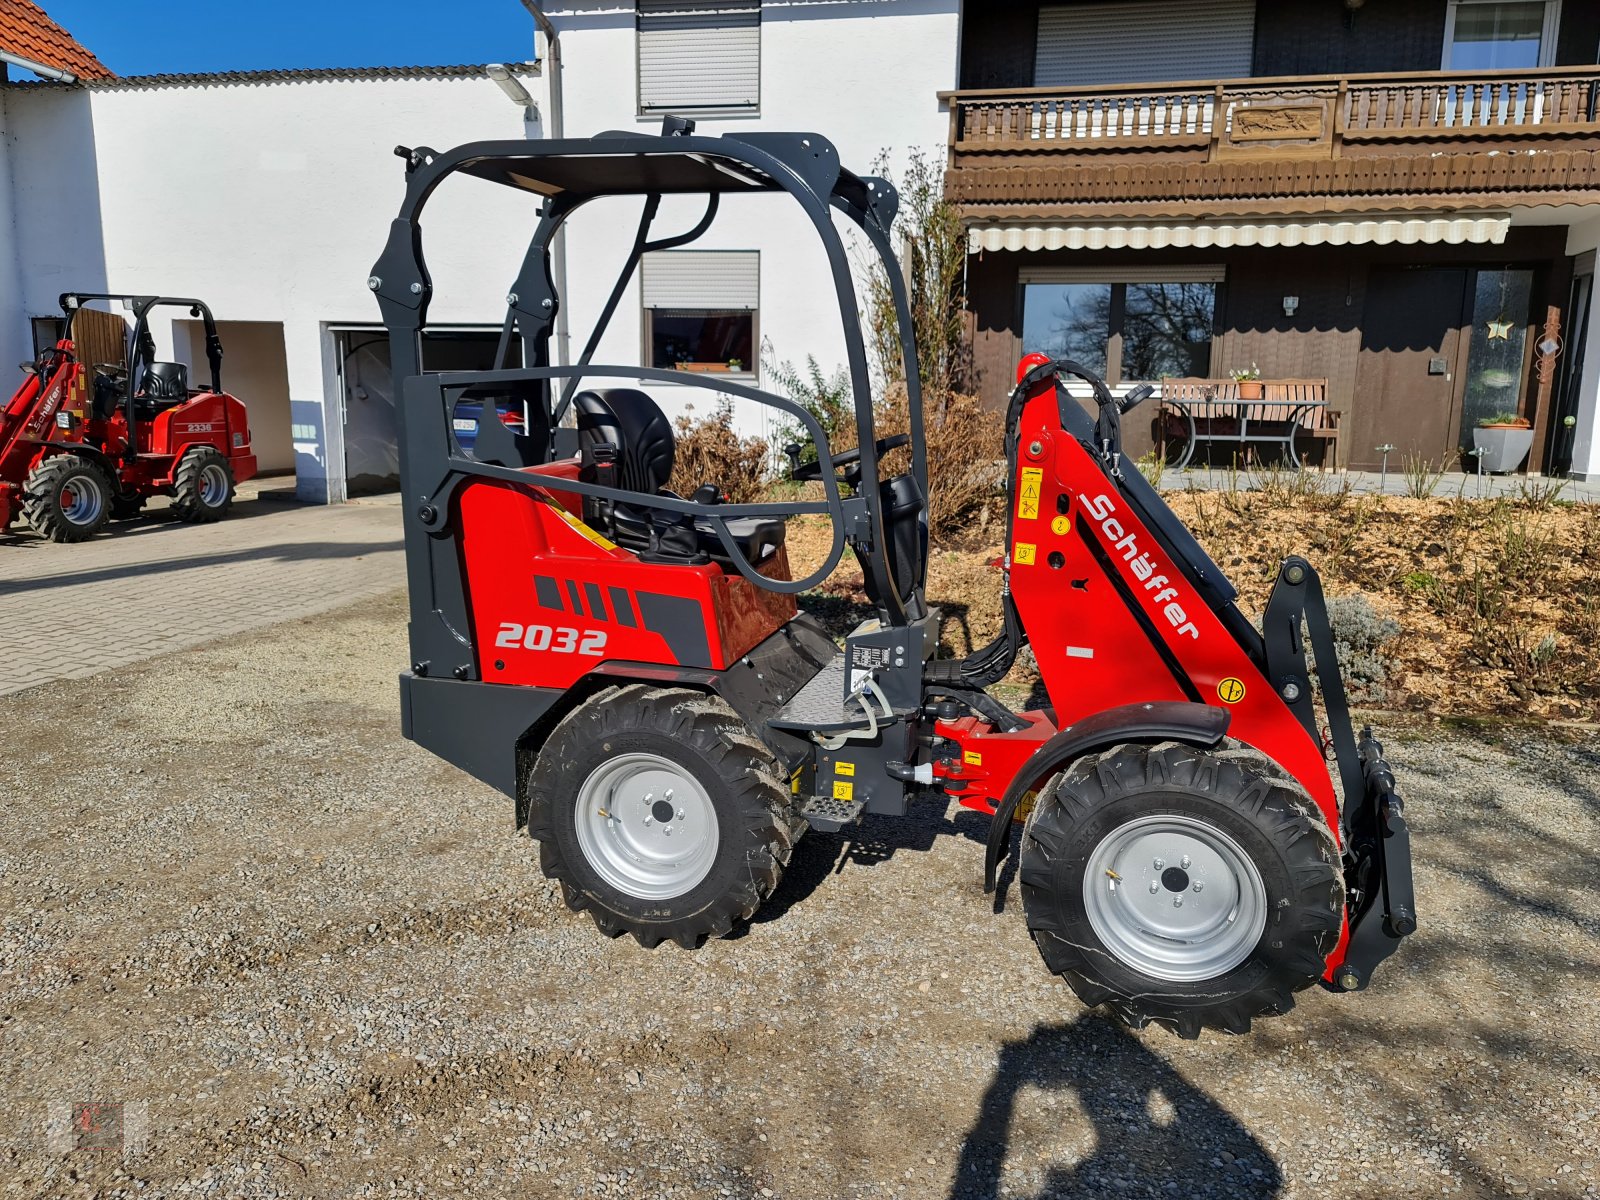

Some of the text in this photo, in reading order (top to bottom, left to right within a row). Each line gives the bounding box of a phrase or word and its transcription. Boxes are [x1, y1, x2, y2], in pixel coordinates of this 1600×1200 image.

[33, 386, 60, 432] Schäffer
[1079, 494, 1199, 640] Schäffer
[495, 622, 607, 656] 2032
